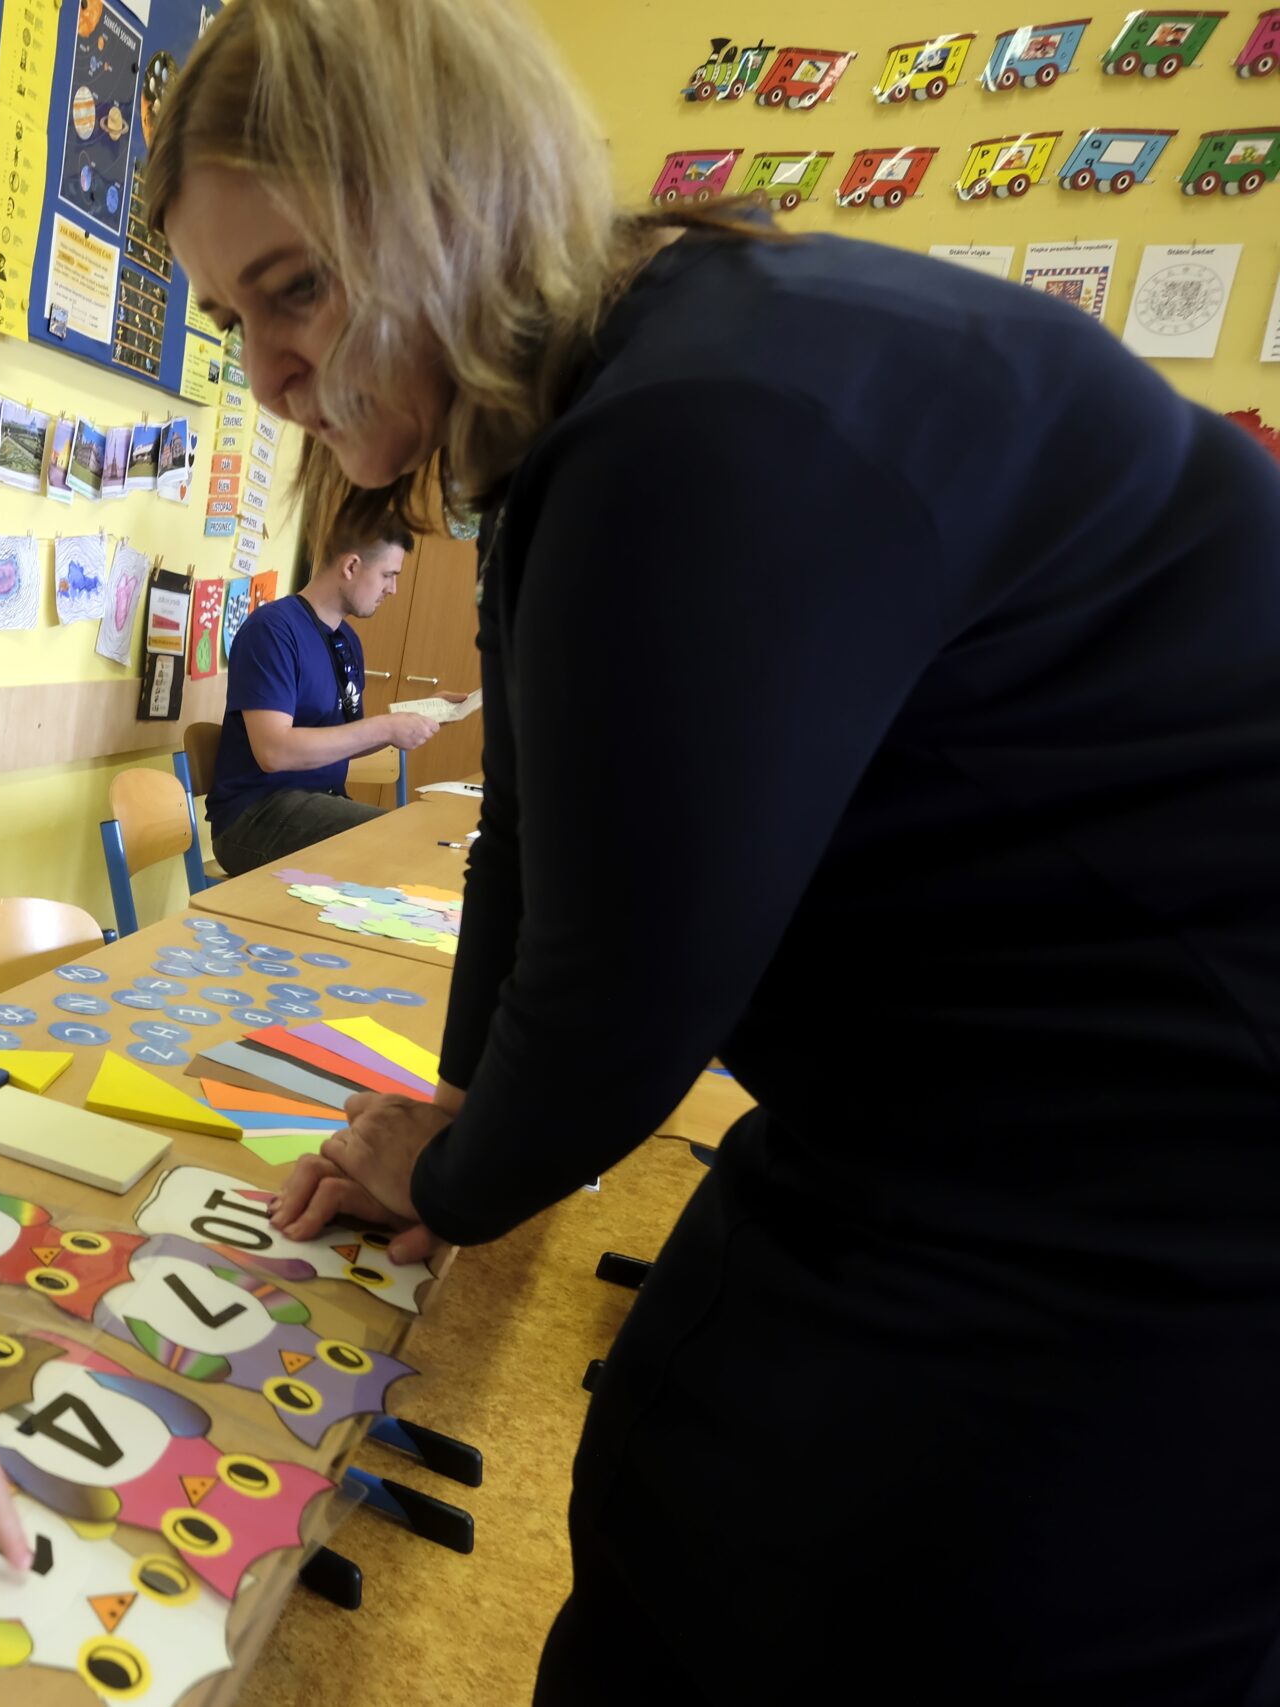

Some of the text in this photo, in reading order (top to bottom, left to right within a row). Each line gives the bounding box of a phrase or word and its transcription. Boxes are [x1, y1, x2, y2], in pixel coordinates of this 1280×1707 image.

[784, 58, 794, 68] A
[899, 54, 909, 63] B
[1212, 141, 1224, 152] R
[980, 149, 990, 159] P
[674, 161, 683, 169] N
[863, 158, 873, 168] O
[179, 1009, 207, 1018] E
[244, 1012, 273, 1024] B
[146, 1025, 180, 1039] H
[190, 1188, 273, 1251] 10
[163, 1273, 248, 1329] 7
[16, 1392, 124, 1468] 4
